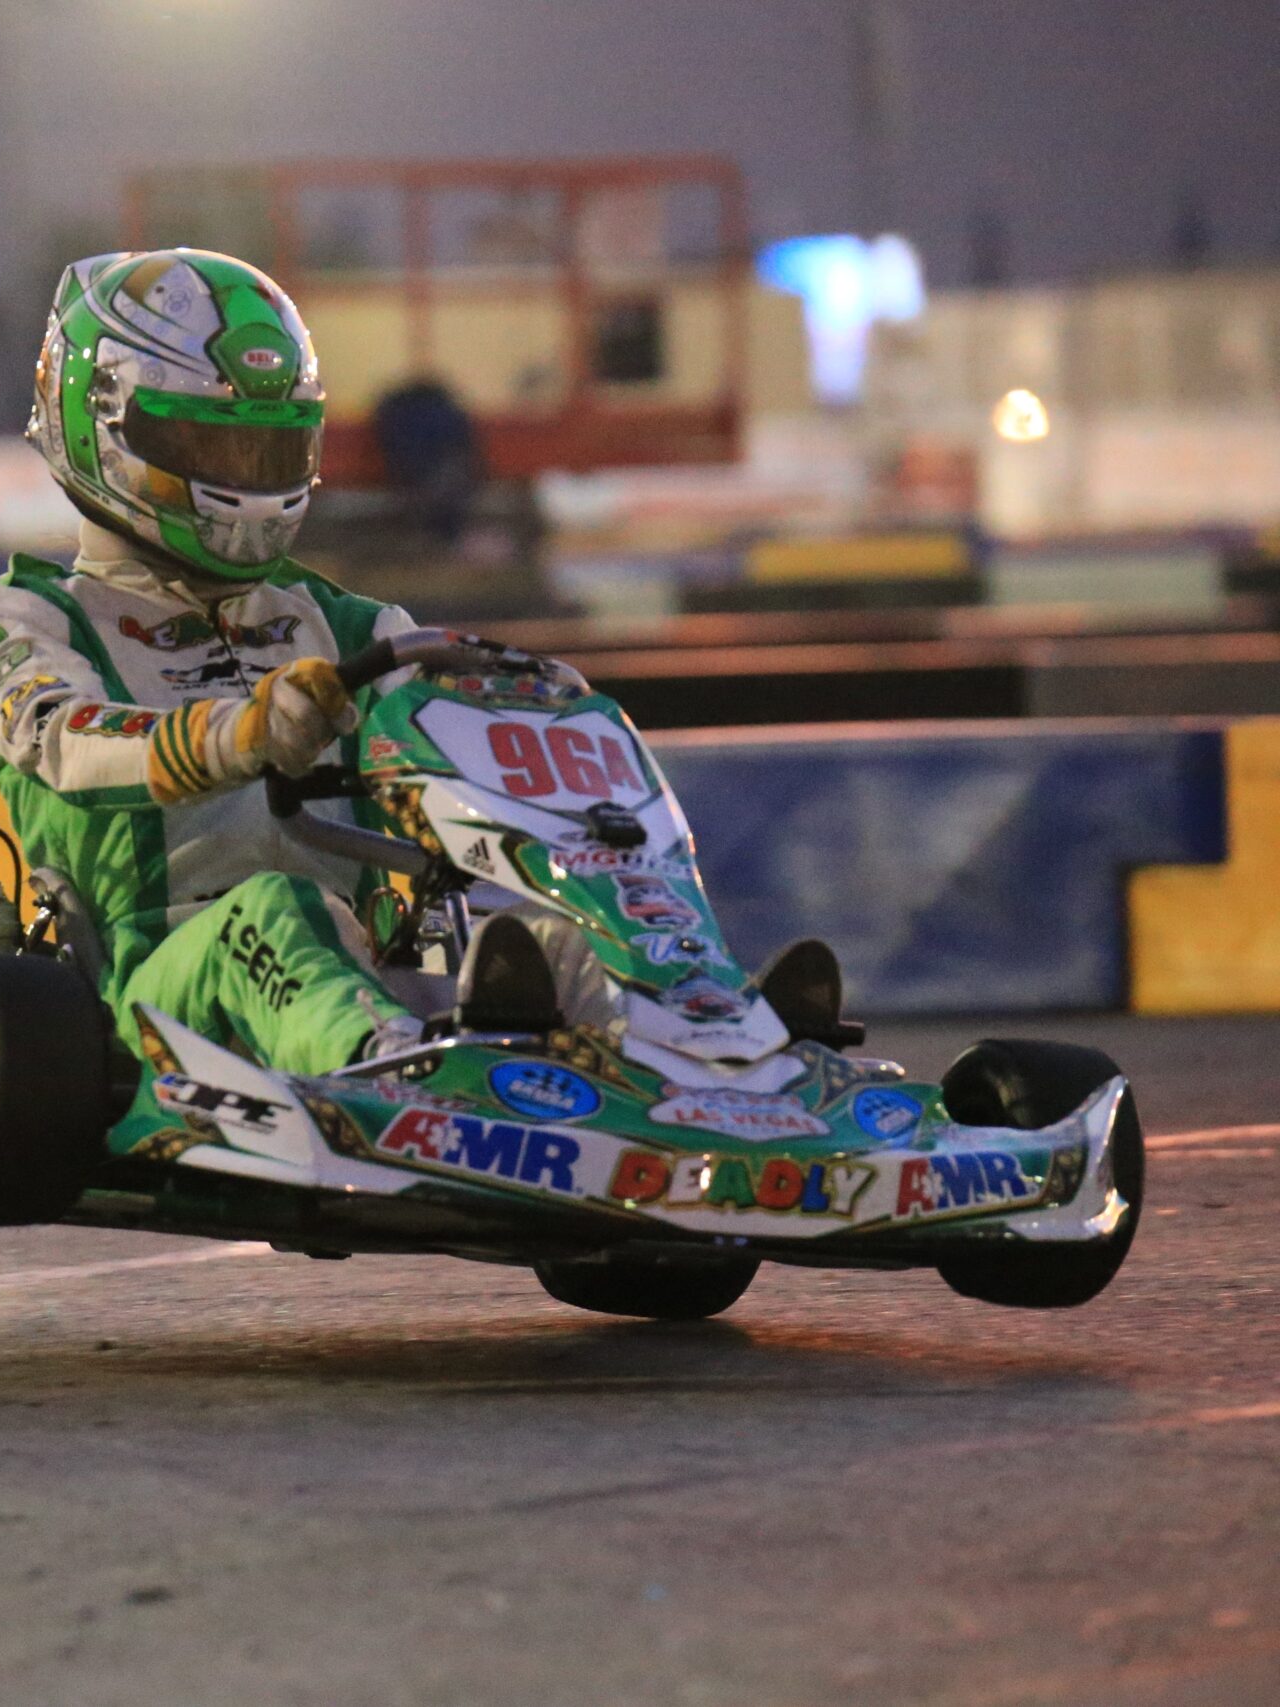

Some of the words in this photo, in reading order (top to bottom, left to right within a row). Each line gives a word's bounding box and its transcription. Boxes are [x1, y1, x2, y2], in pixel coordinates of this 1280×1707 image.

[486, 722, 645, 798] 96A
[380, 1108, 580, 1193] AMR
[610, 1150, 876, 1216] DEADLY
[895, 1151, 1029, 1217] AMR
